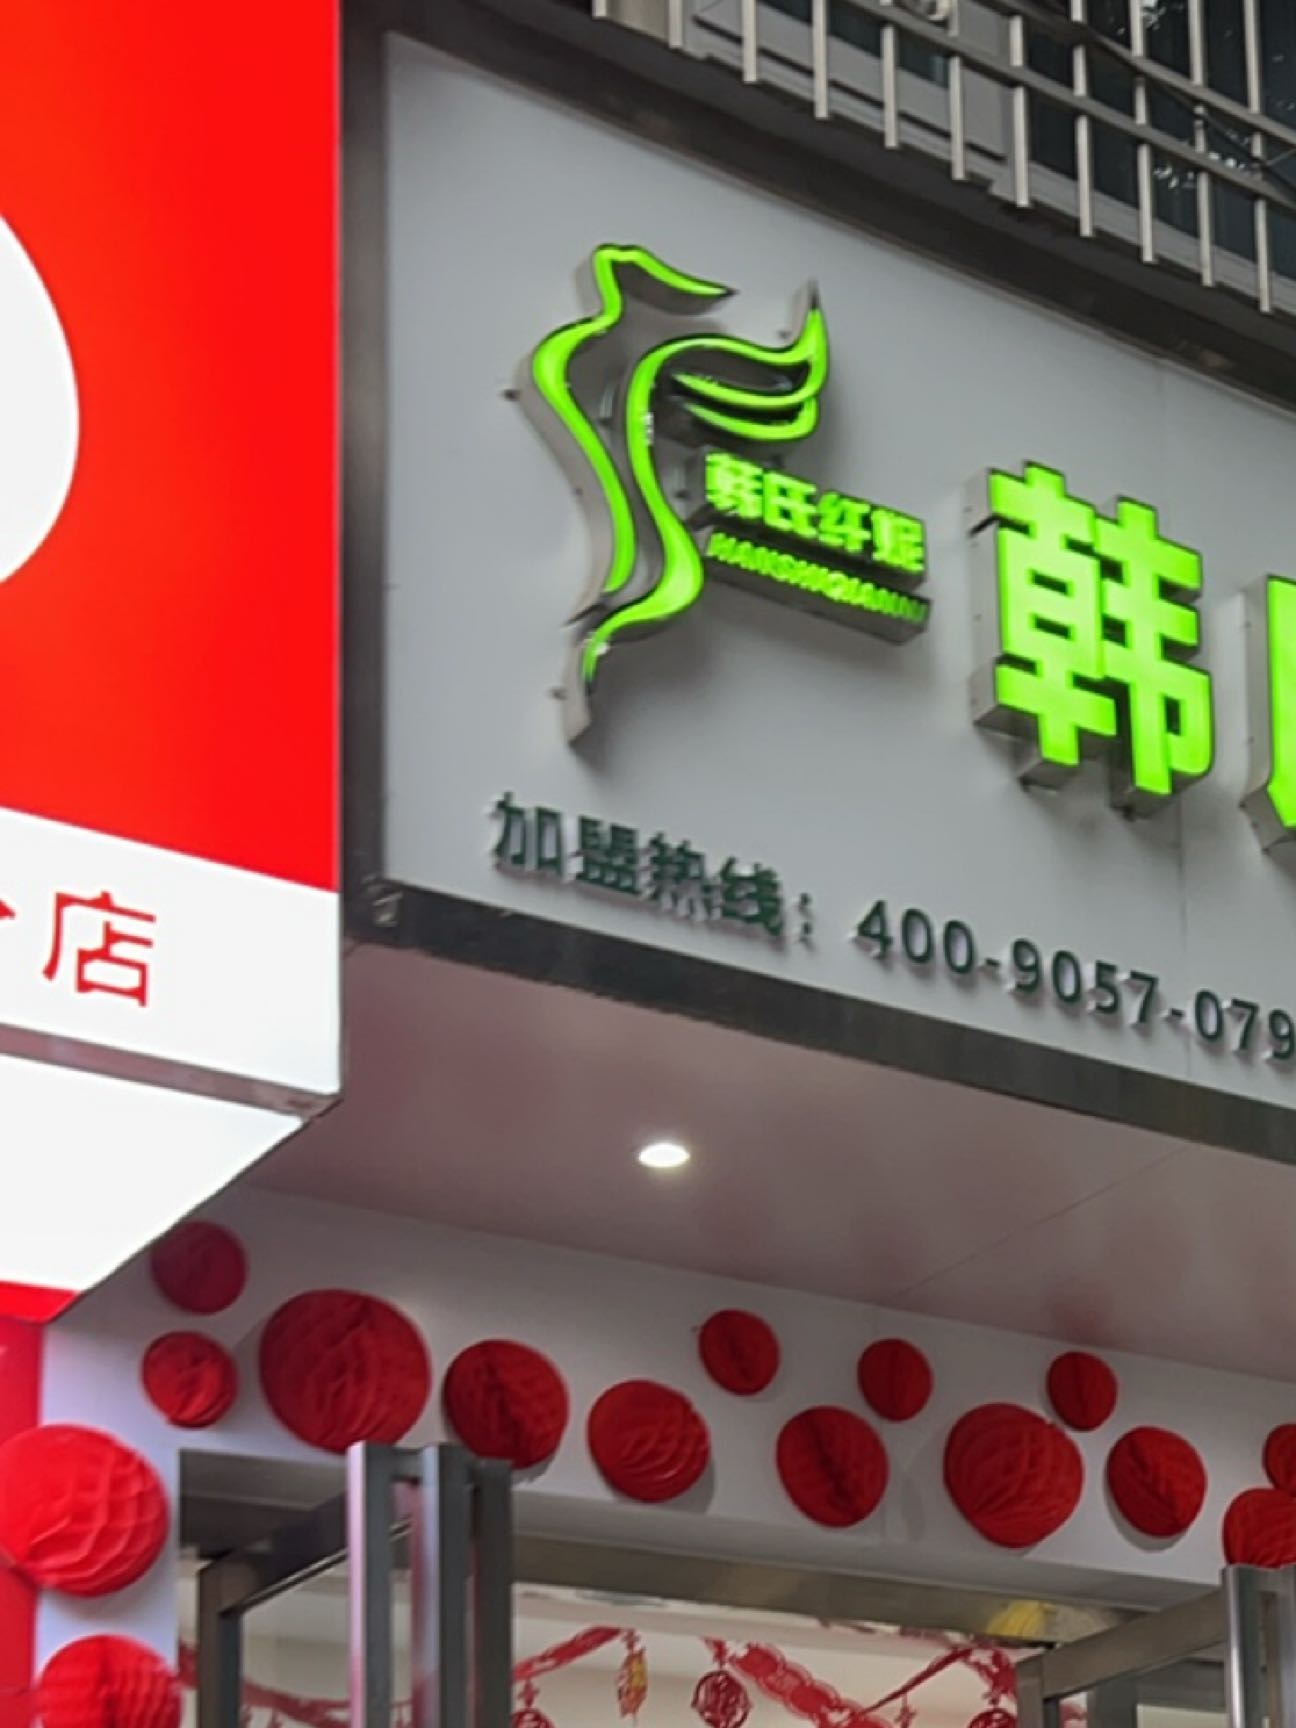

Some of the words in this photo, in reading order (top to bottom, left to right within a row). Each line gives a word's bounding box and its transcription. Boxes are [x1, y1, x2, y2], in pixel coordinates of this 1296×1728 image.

[705, 452, 925, 573] 韩氏纤妮
[0, 890, 157, 1008] 店
